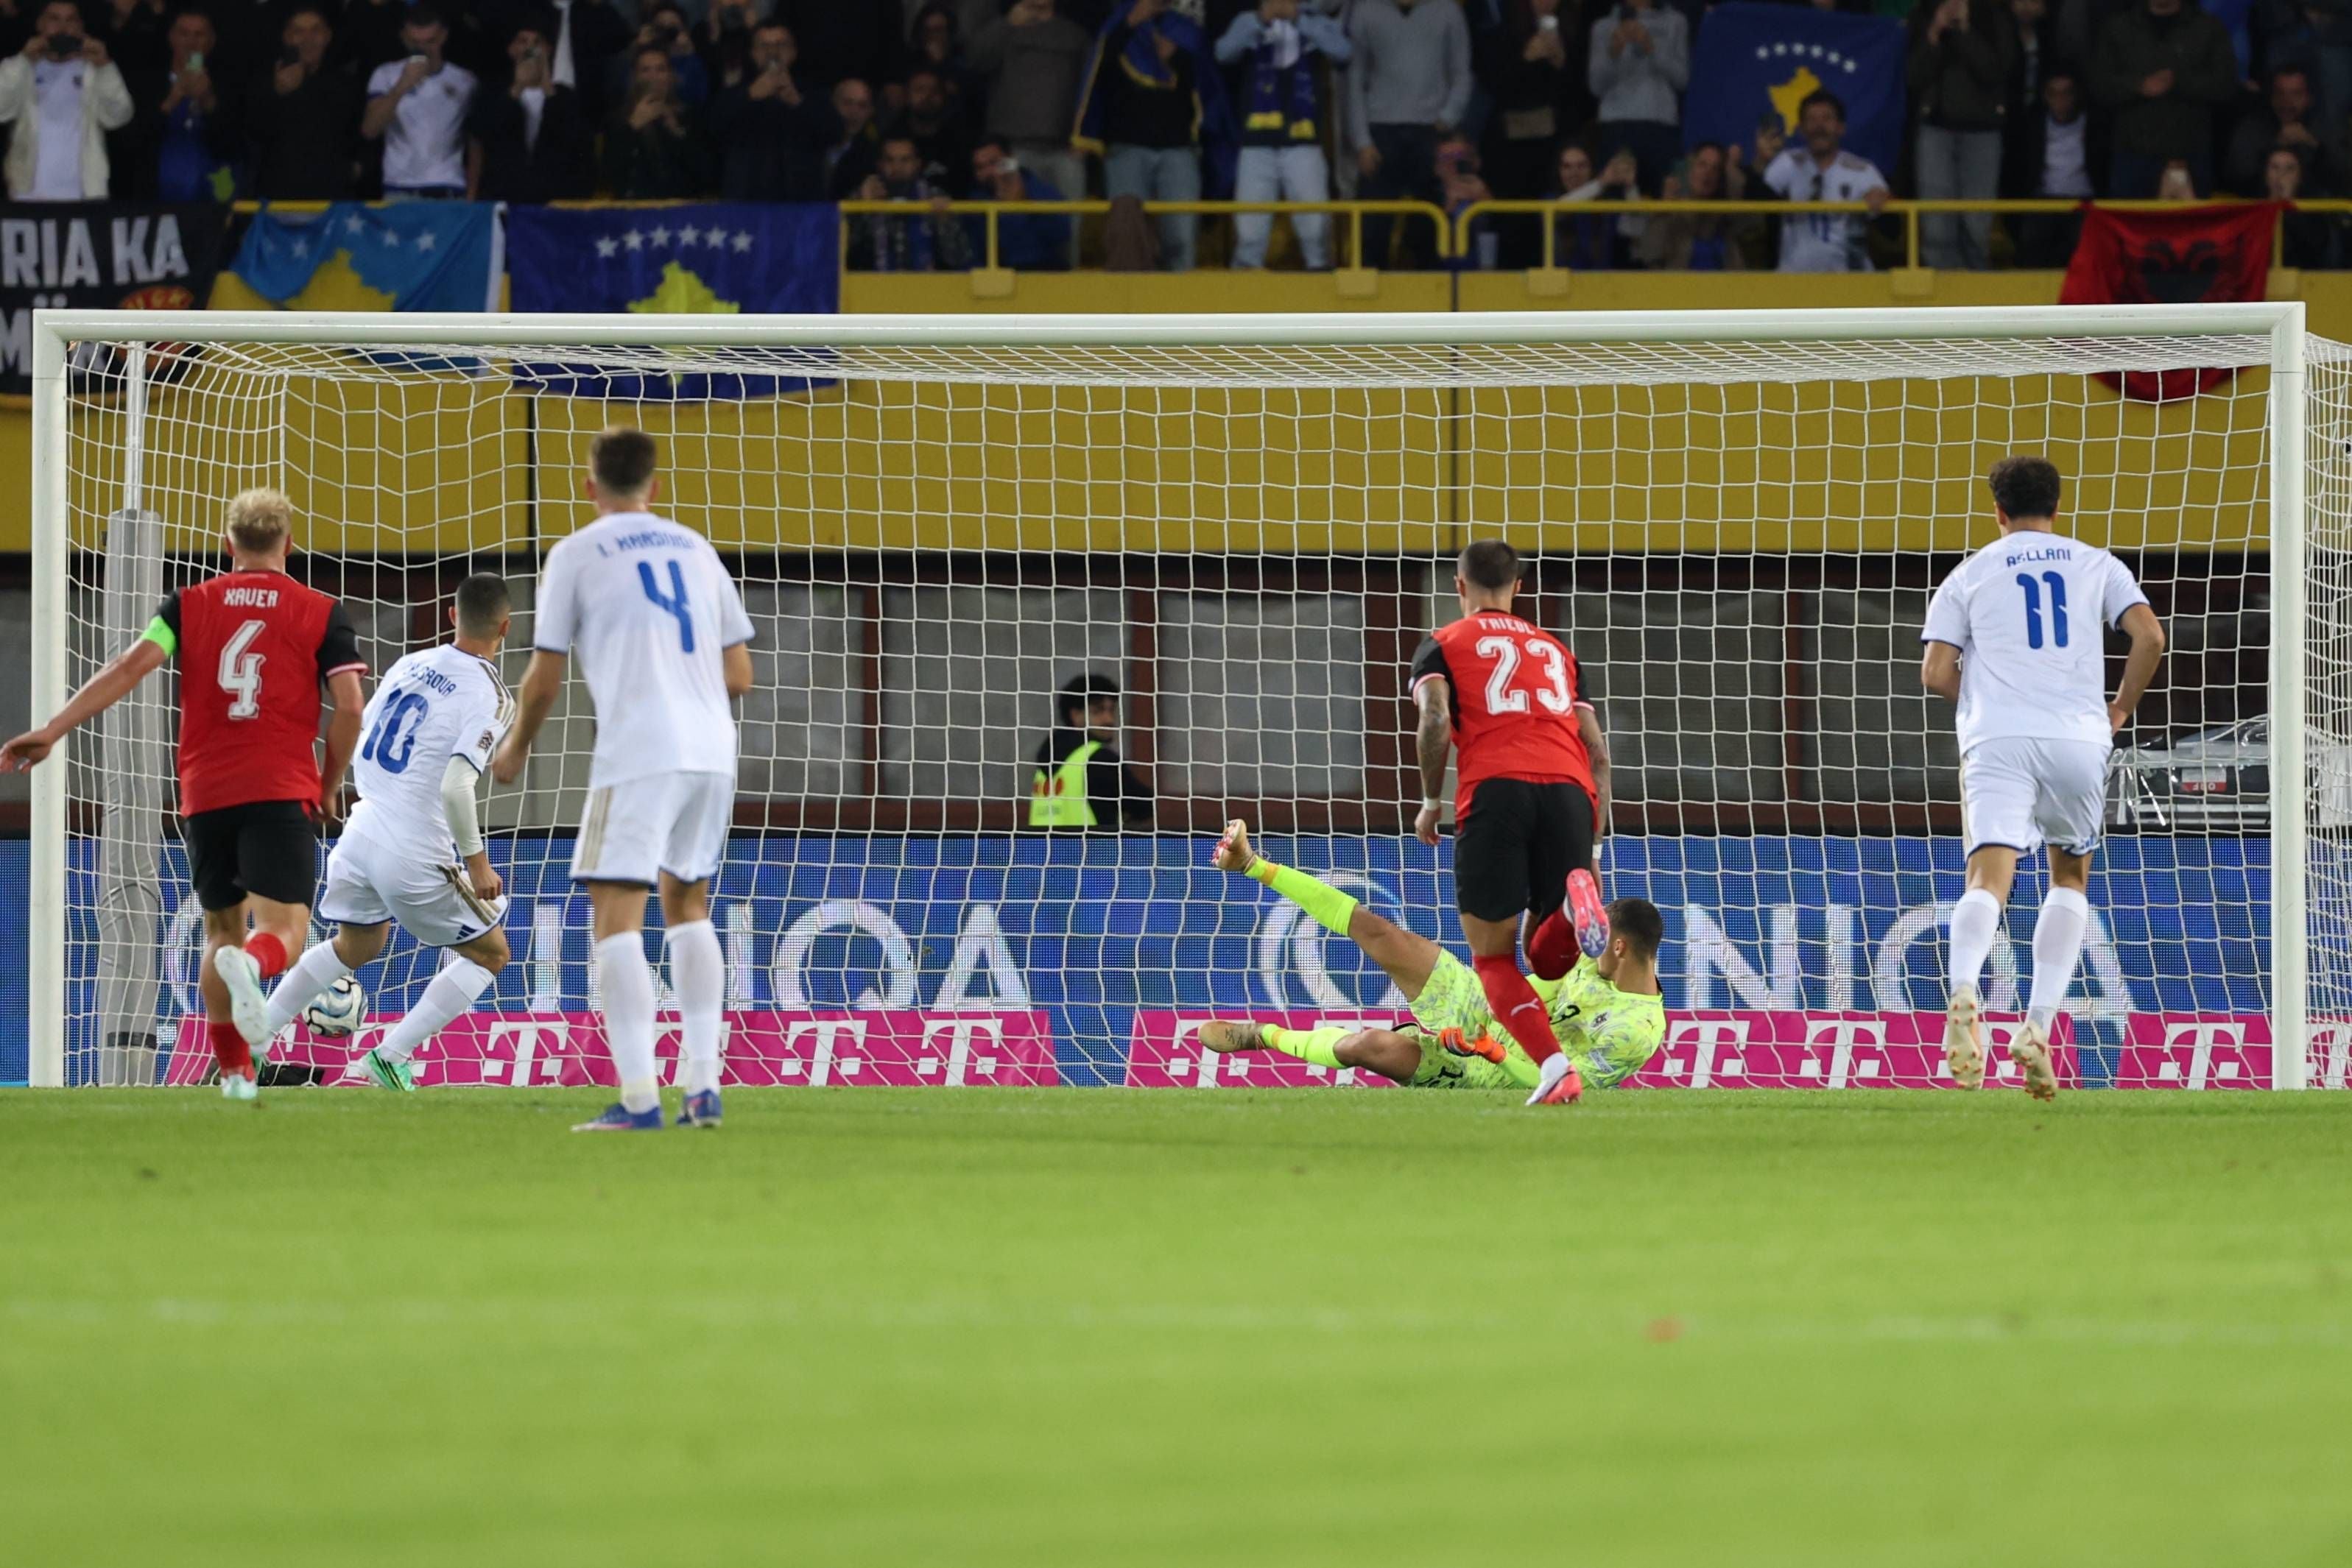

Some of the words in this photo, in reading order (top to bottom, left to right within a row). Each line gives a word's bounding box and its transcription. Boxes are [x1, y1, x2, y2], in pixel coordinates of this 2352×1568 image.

[1, 217, 101, 288] RIA
[111, 213, 190, 286] KA
[2007, 548, 2071, 567] ASLLANI
[637, 559, 694, 654] 4
[2015, 570, 2068, 649] 11
[217, 619, 267, 720] 4
[1476, 636, 1573, 716] 23
[362, 688, 429, 774] 10
[781, 1020, 867, 1087] T
[917, 1019, 1003, 1087] T
[1662, 1020, 1750, 1088] T
[1799, 1020, 1887, 1089] T
[2158, 1023, 2246, 1090] T
